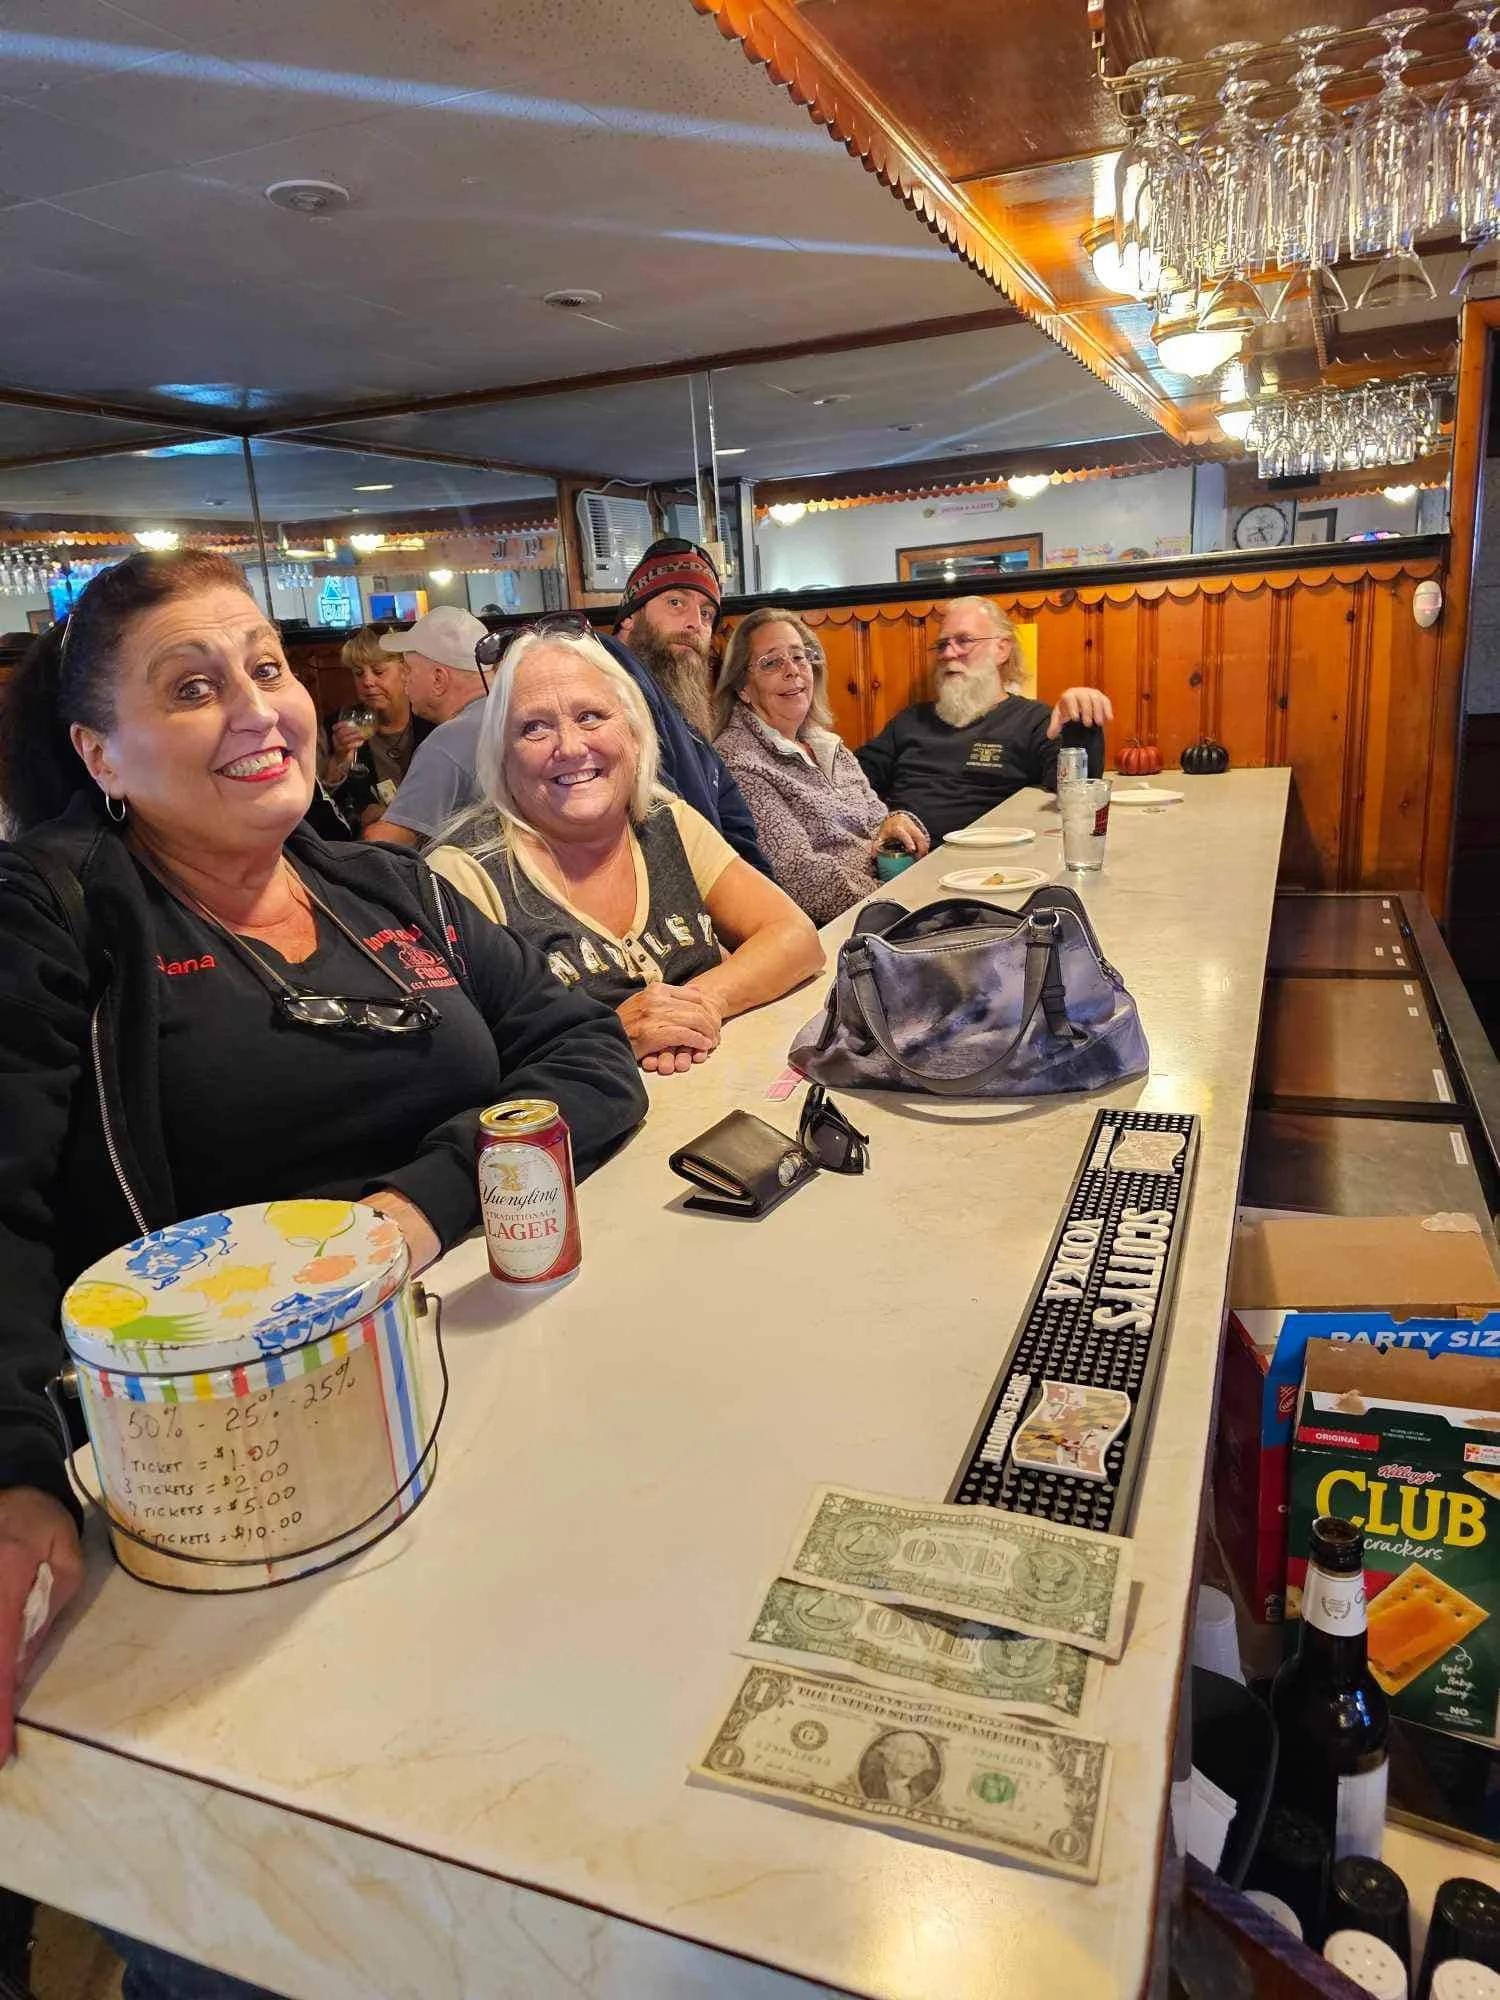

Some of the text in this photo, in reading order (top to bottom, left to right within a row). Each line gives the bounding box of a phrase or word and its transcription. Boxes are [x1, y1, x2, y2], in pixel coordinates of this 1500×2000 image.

[547, 912, 713, 988] HALEY
[480, 1183, 560, 1210] Yuengling
[487, 1218, 560, 1241] LAGER
[1042, 1217, 1104, 1301] VODKA
[128, 1407, 183, 1439] 50%
[303, 1357, 356, 1409] 25%
[1315, 1432, 1360, 1445] ORIGINAL
[131, 1460, 182, 1473] TICKET
[1378, 1464, 1437, 1485] Kellogg's
[137, 1484, 194, 1496] TICKETS
[144, 1504, 204, 1518] TICKETS
[1316, 1470, 1487, 1547] CLUB
[152, 1532, 210, 1546] TICKETS
[1363, 1538, 1444, 1560] crackers
[1449, 1705, 1469, 1717] NO
